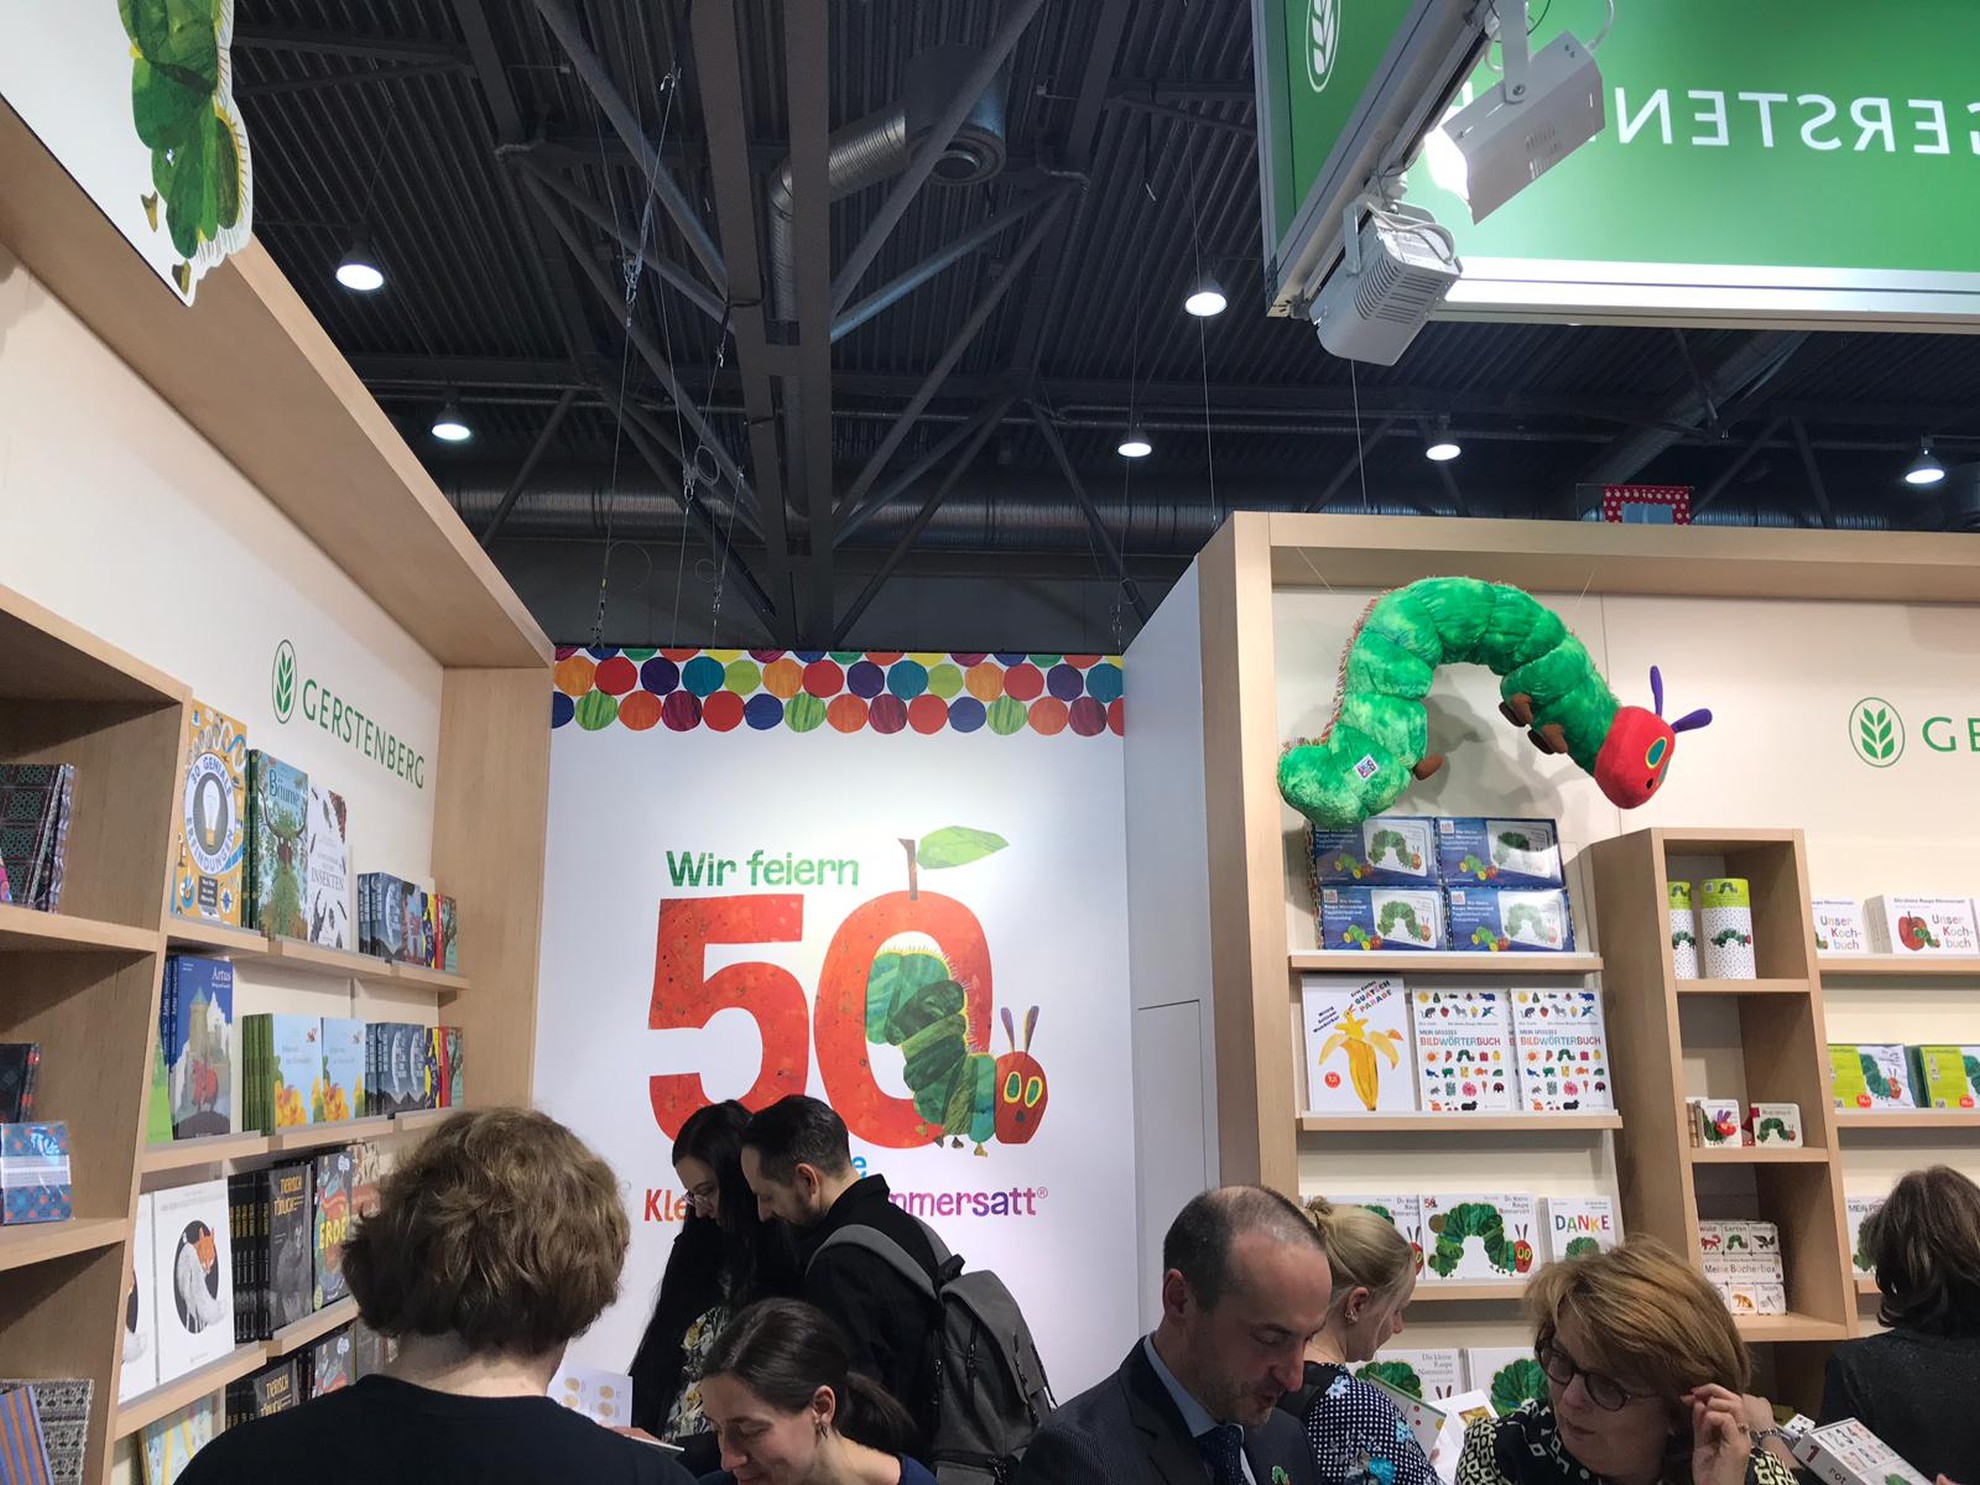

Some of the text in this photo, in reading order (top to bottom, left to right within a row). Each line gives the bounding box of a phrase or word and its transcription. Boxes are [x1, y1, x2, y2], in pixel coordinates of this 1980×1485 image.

[302, 678, 425, 789] GERSTENBERG
[666, 849, 859, 887] Wir feiern
[311, 867, 344, 892] INSEKTEN
[1820, 915, 1852, 926] Unser
[1932, 914, 1964, 925] Unser
[1831, 928, 1861, 938] Koch-
[1943, 926, 1974, 937] Koch-
[1834, 940, 1859, 950] buch
[1946, 938, 1971, 949] buch
[212, 966, 232, 981] Artus
[648, 890, 993, 1149] 50
[1420, 1036, 1501, 1047] BILDWÖRTERBUCH
[1520, 1035, 1601, 1046] BILDWÖRTERBUCH
[644, 1188, 687, 1222] Kle
[1555, 1214, 1610, 1233] DANKE
[319, 1216, 347, 1250] ERDE
